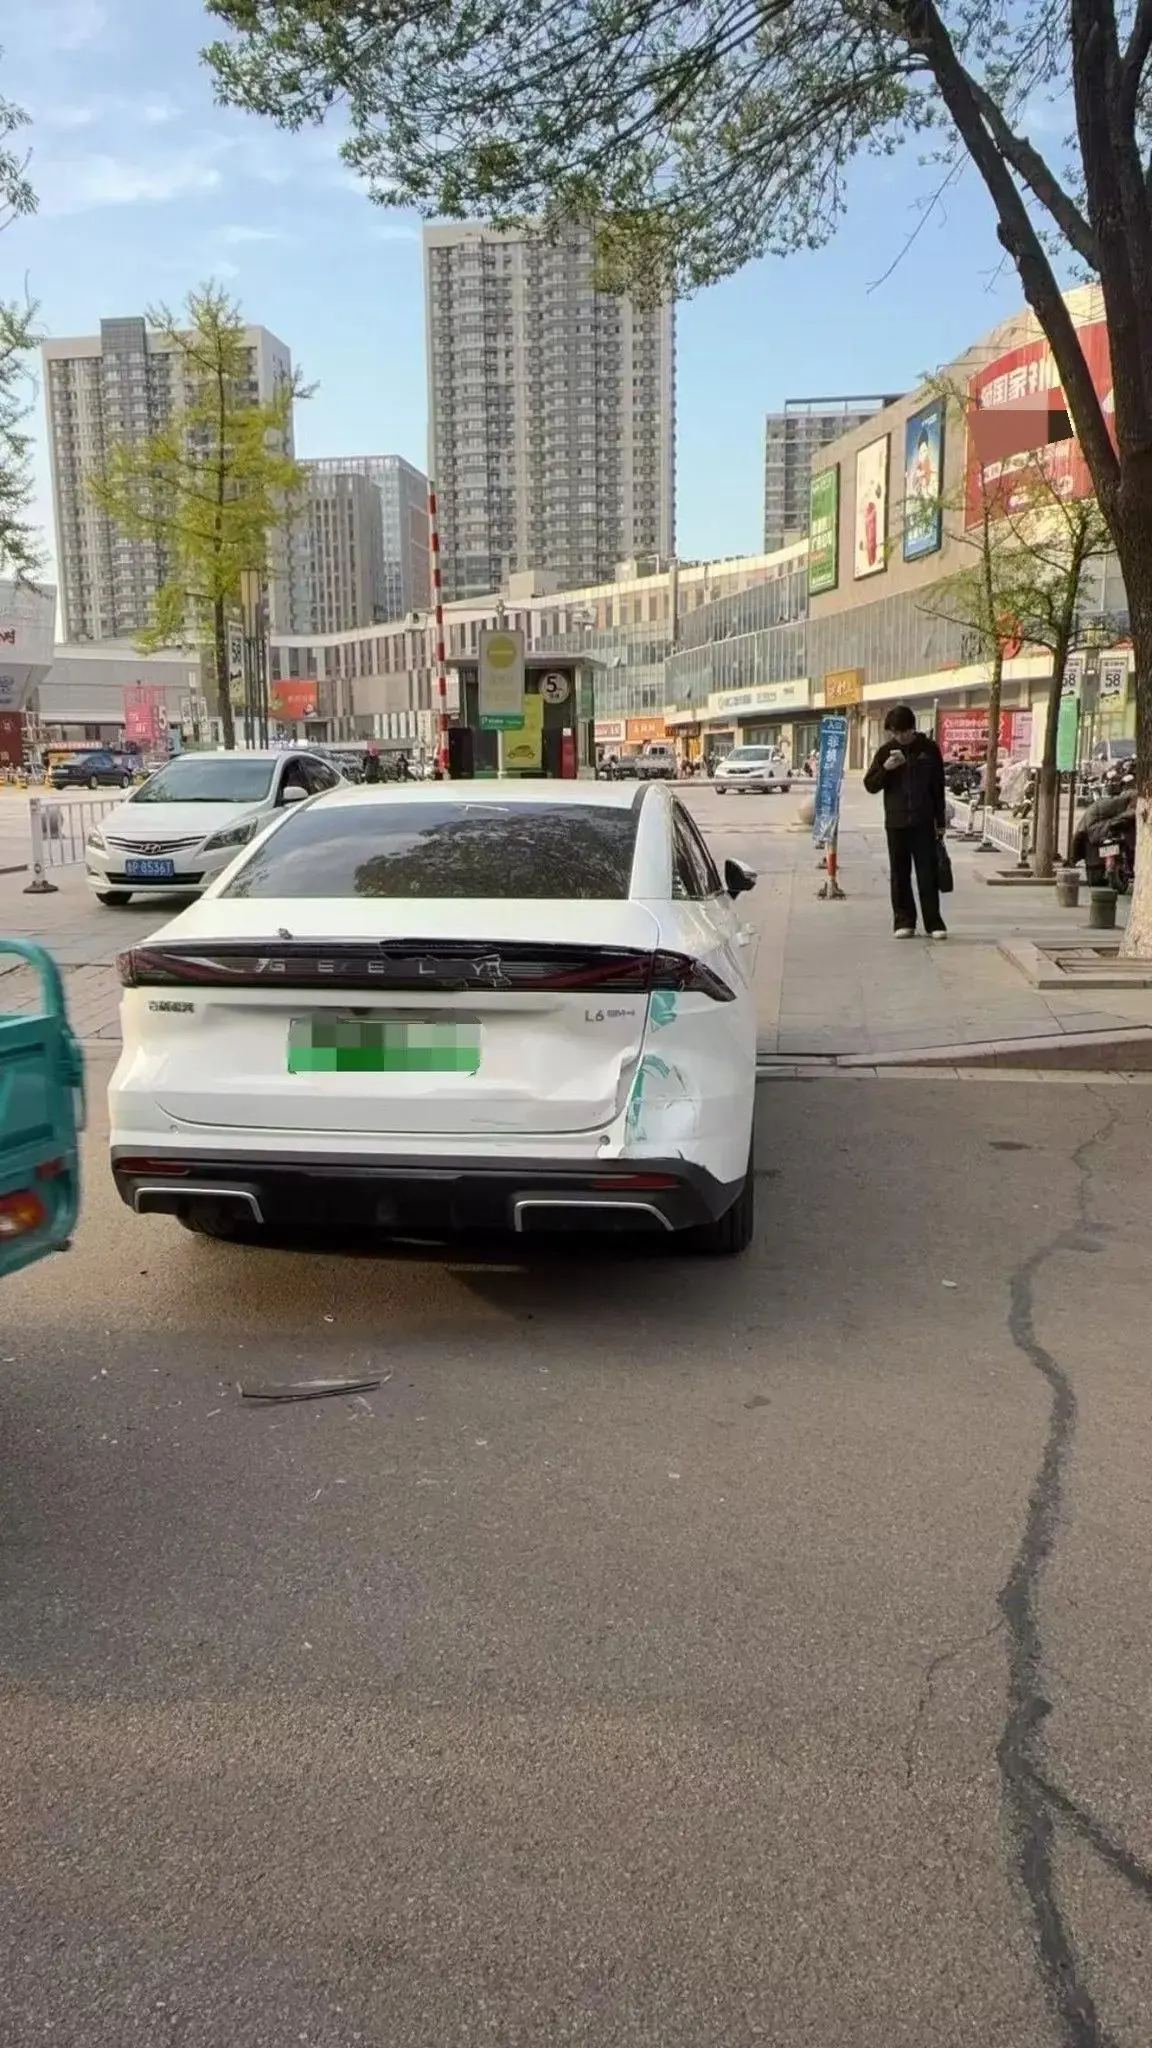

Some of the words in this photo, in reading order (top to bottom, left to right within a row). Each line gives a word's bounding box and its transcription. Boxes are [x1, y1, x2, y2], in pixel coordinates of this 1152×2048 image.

[546, 676, 558, 693] 5
[1105, 673, 1121, 688] 58
[585, 1009, 605, 1023] L6
